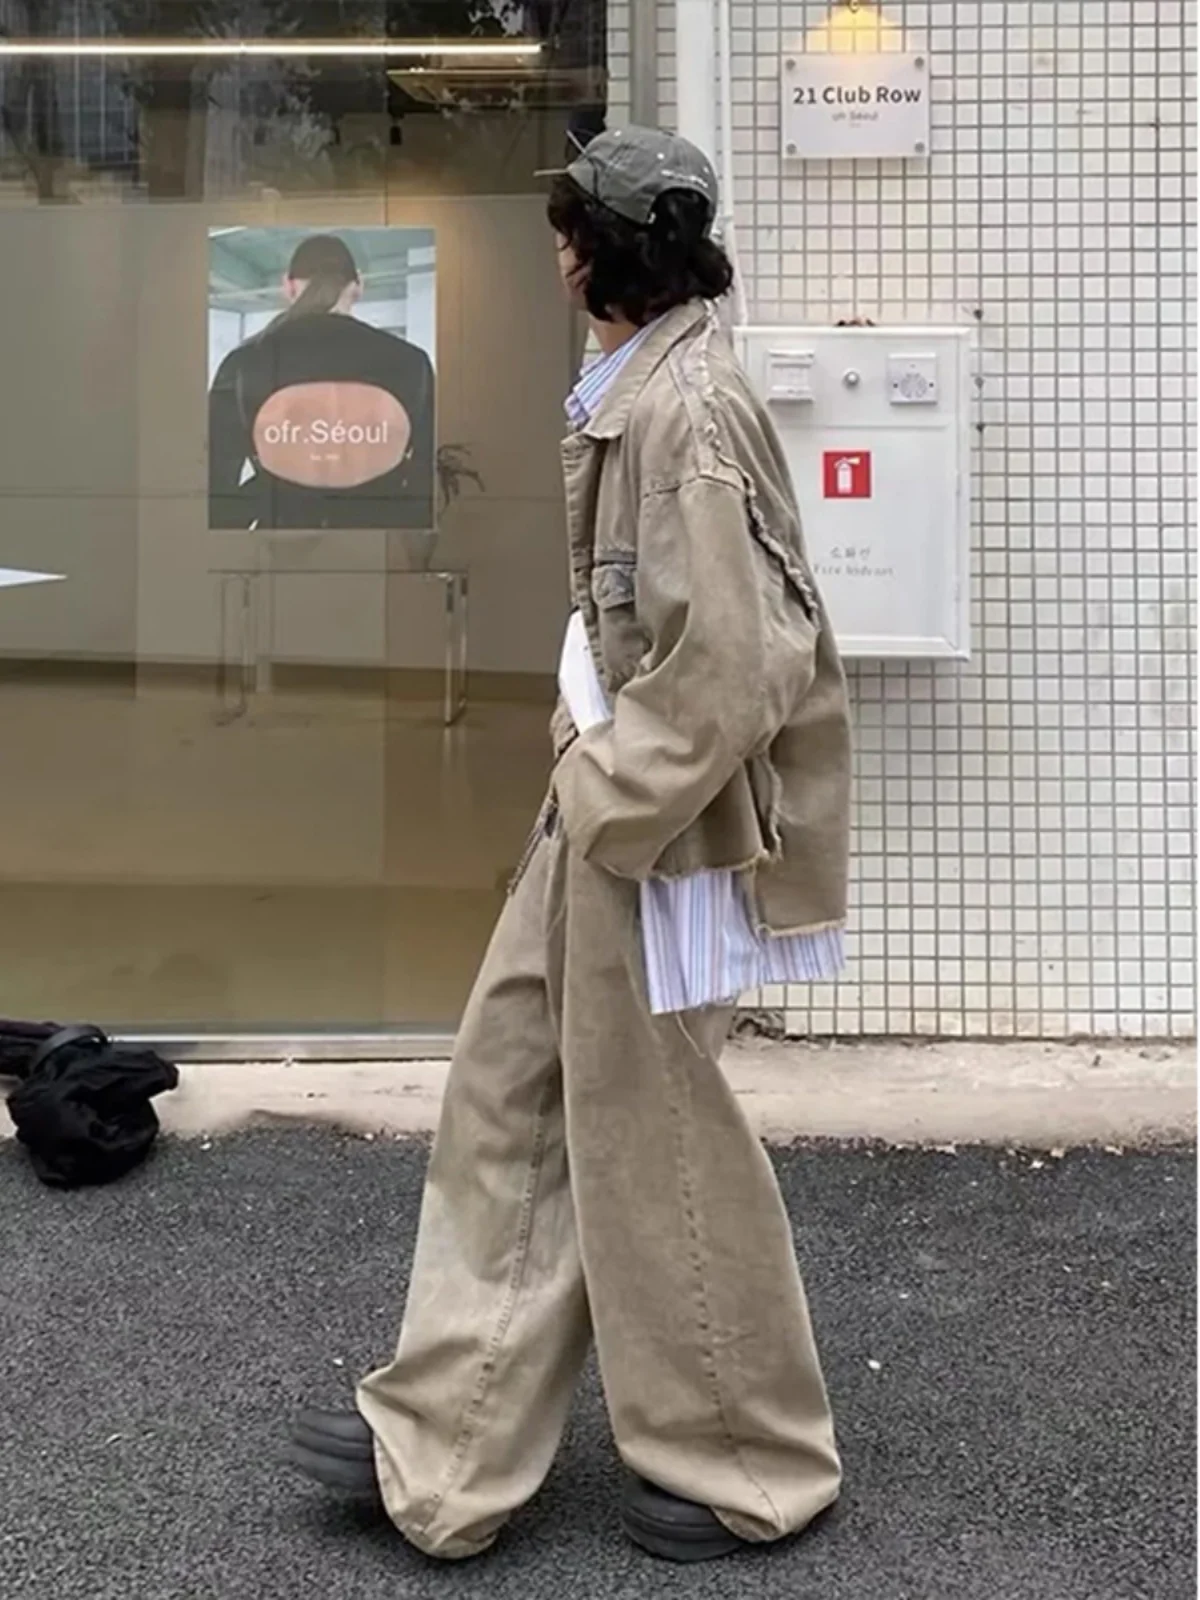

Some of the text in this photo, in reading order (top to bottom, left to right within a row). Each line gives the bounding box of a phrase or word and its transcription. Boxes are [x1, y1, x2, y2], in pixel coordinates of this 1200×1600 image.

[793, 86, 922, 104] 21 Club Row
[264, 419, 389, 444] ofr.Séoul
